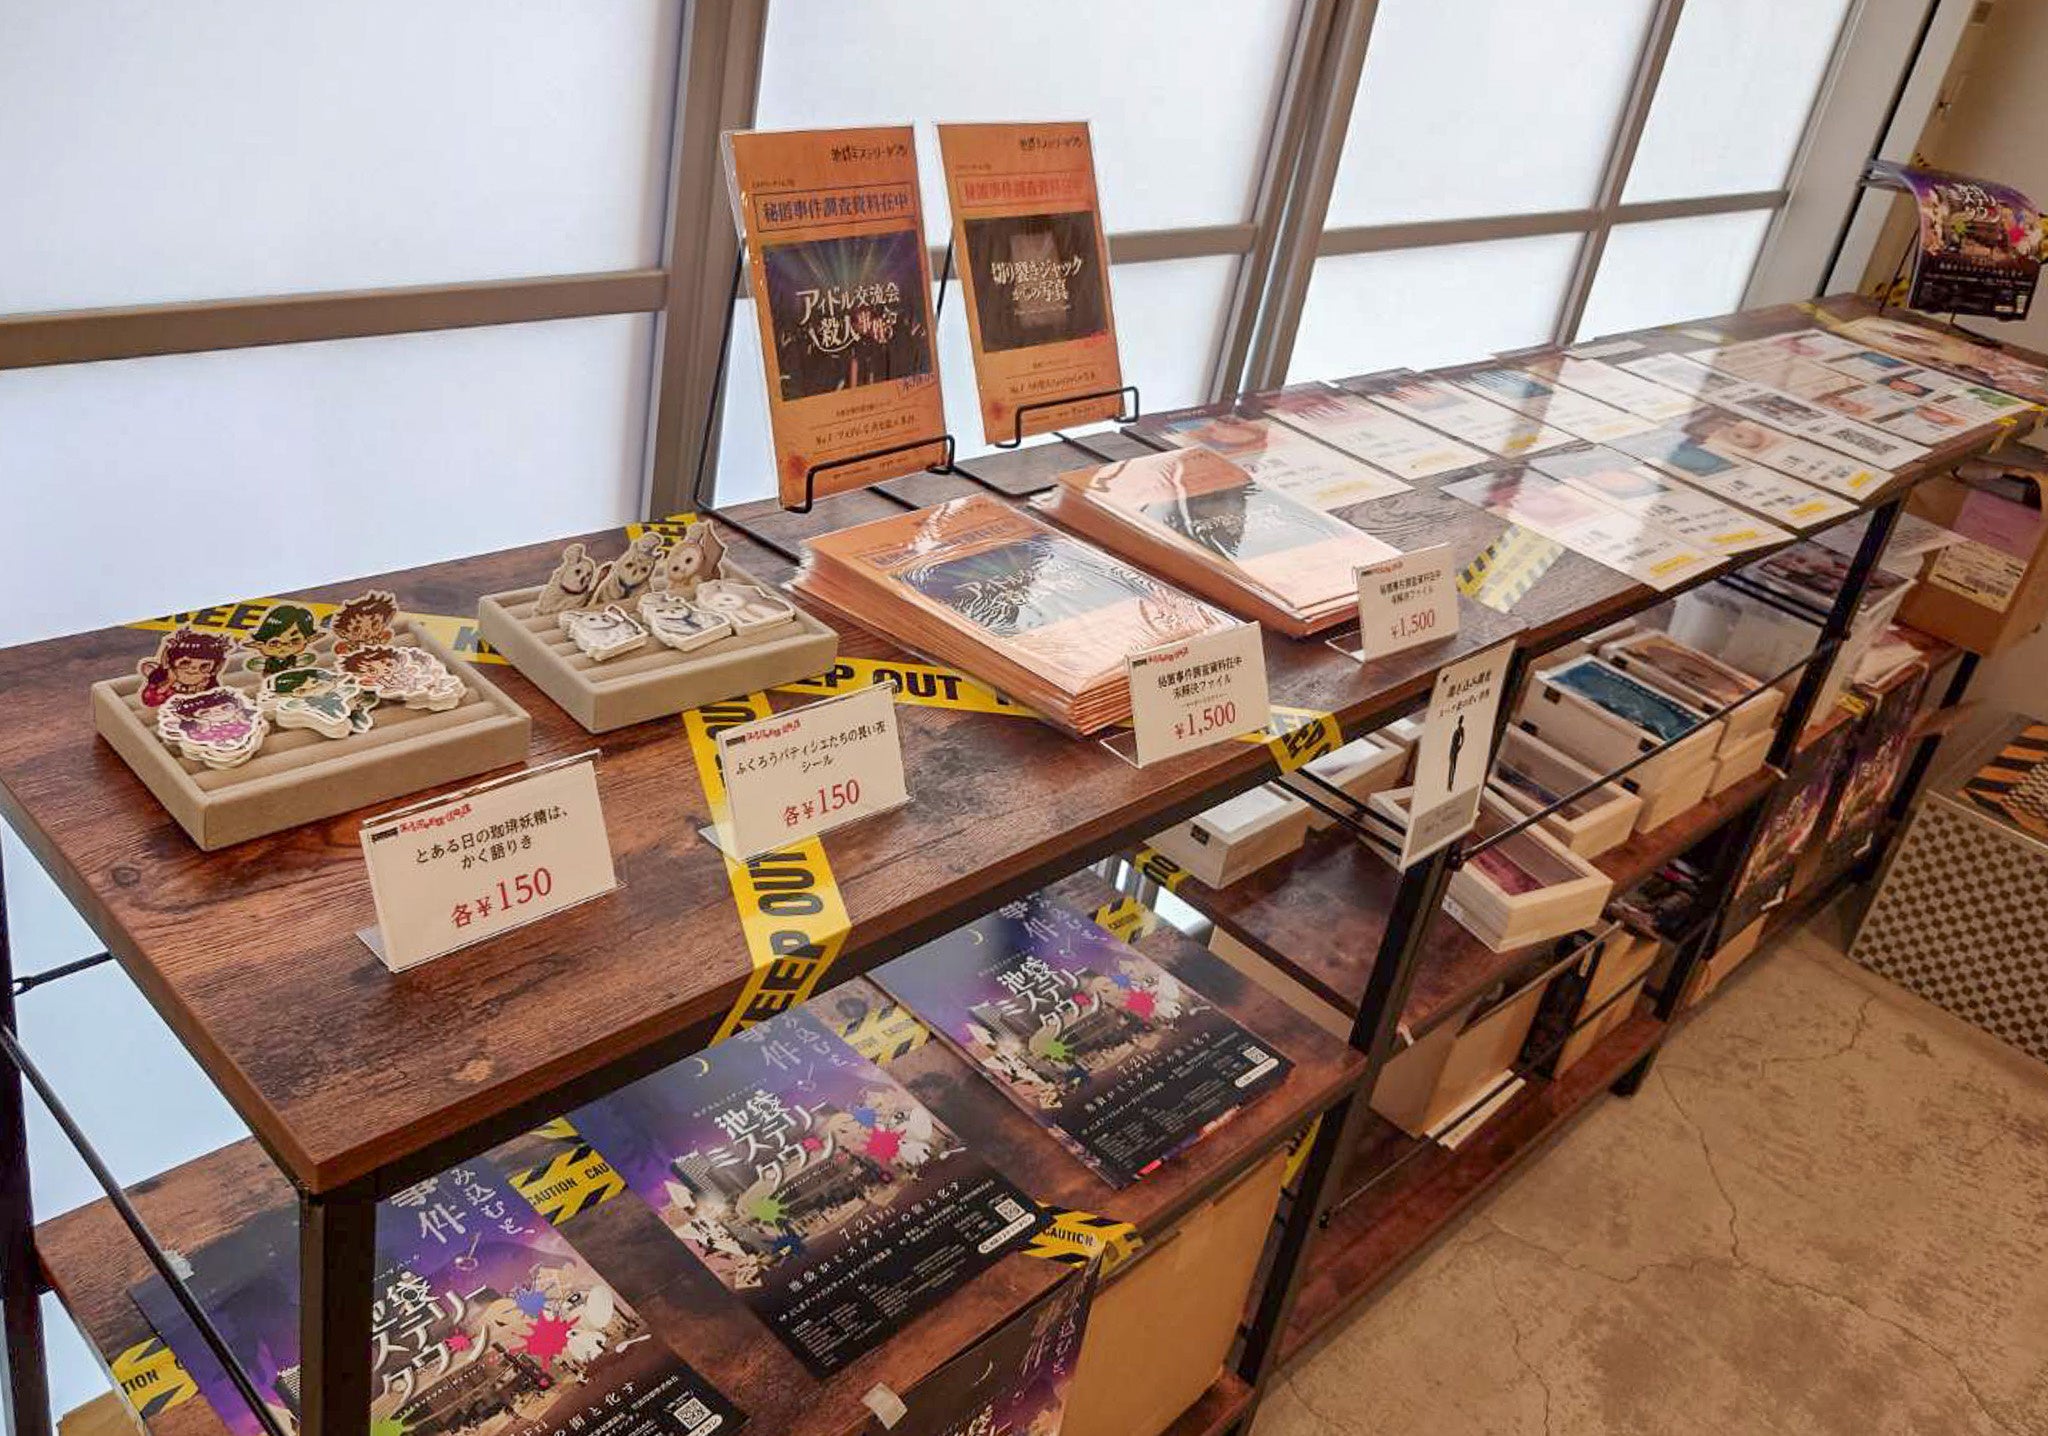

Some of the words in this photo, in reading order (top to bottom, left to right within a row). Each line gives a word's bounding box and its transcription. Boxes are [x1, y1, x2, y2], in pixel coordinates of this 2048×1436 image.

[1391, 608, 1435, 639] ¥1,500
[1174, 701, 1236, 739] ¥1,500
[416, 805, 568, 864] とある日の珈琲妖精は、
[461, 836, 533, 870] かく語りき
[996, 956, 1060, 995] 池袋
[706, 1101, 828, 1168] ミステリー
[713, 1089, 791, 1140] 池袋
[755, 1131, 835, 1193] タウン
[527, 1176, 579, 1206] CAUTION
[381, 1323, 490, 1410] タウン
